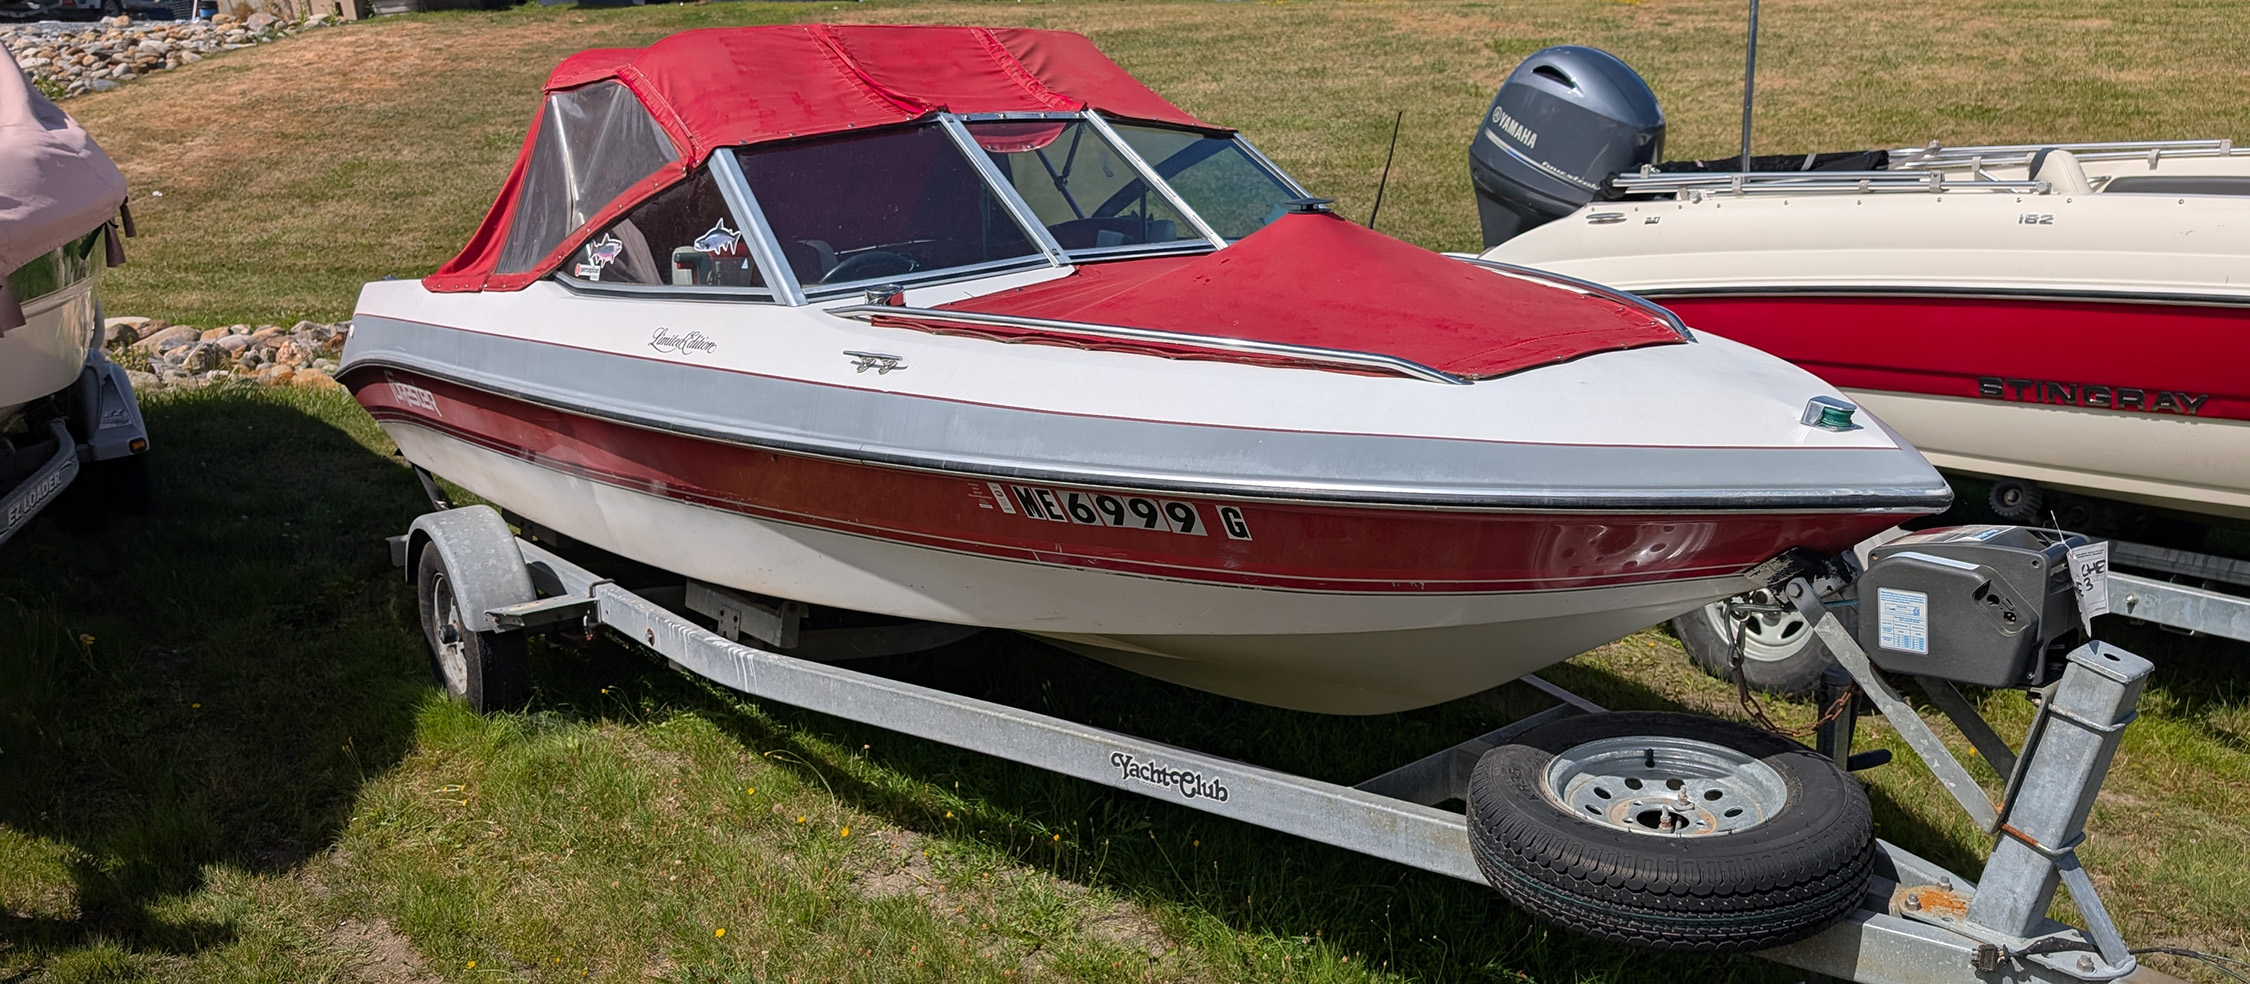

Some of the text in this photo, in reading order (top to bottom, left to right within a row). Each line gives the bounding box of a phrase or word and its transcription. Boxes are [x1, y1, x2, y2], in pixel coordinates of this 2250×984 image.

[1499, 111, 1538, 149] YAMAHA
[647, 327, 717, 355] Limited Edition
[1978, 376, 2209, 414] STINGRAY
[8, 470, 61, 527] EZ LOADER
[1222, 506, 1250, 539] G
[1110, 752, 1229, 802] Yacht Club
